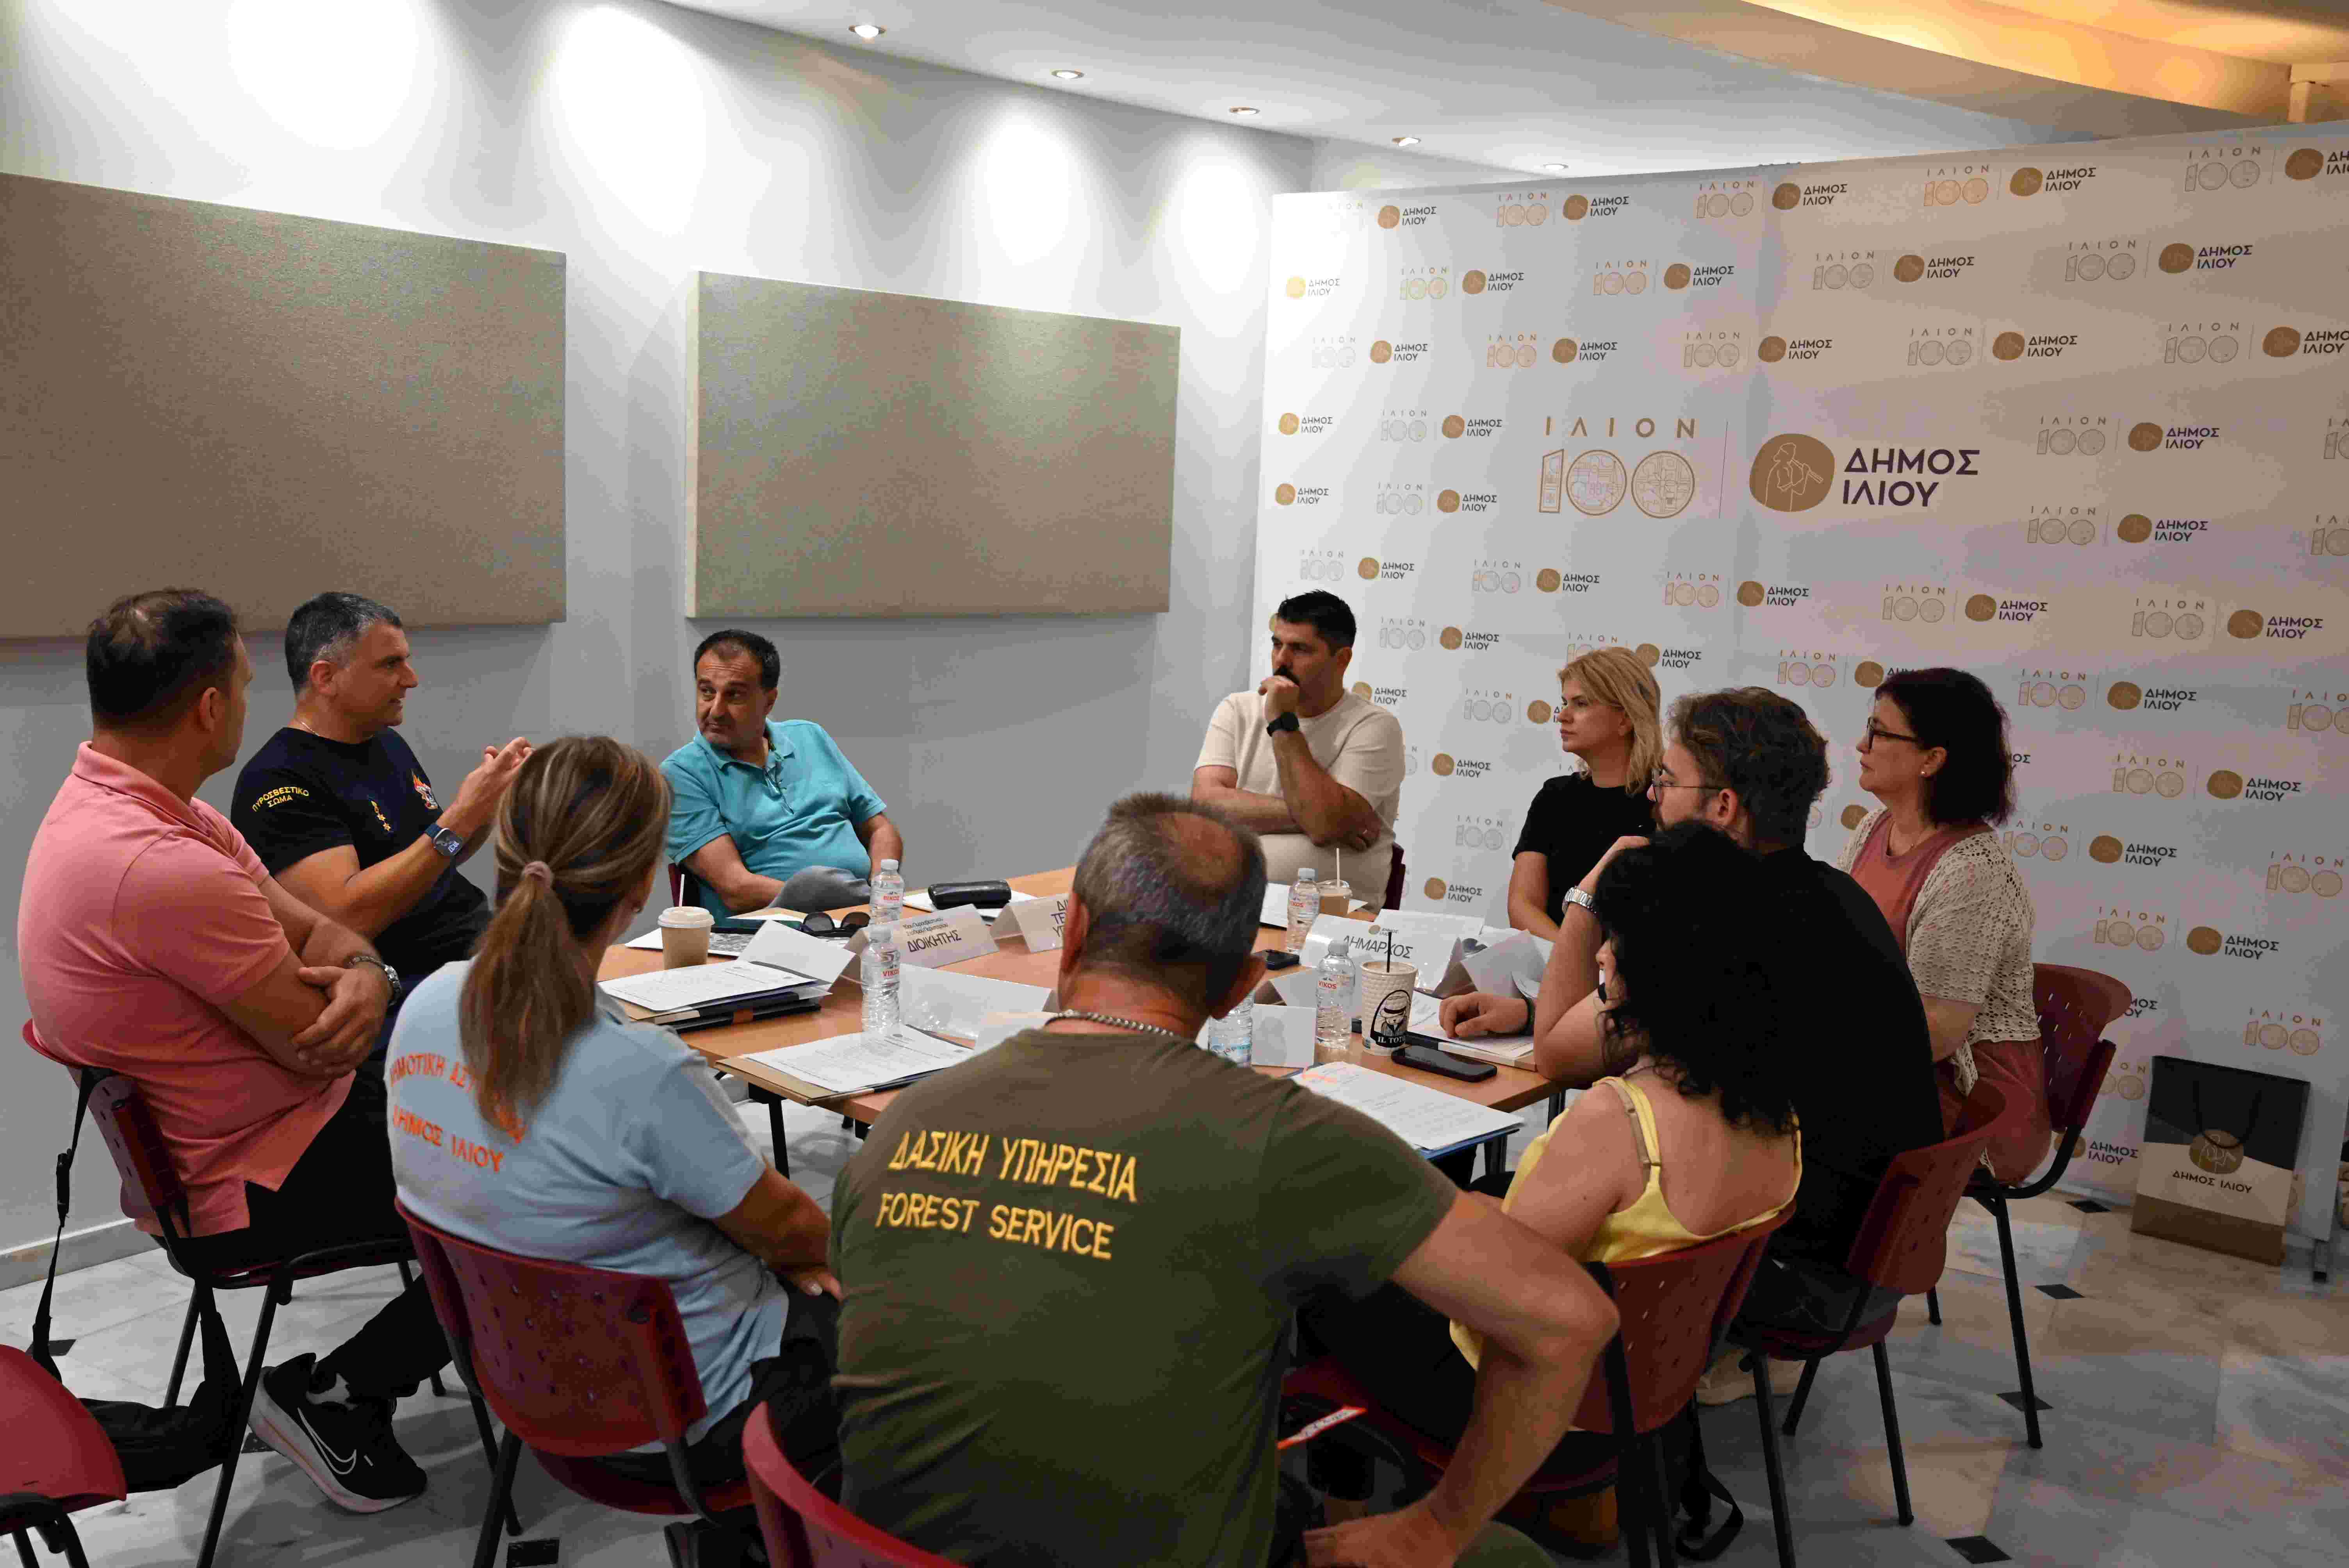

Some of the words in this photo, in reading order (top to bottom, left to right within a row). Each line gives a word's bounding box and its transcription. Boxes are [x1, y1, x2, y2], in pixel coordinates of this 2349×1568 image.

[2190, 147, 2260, 159] ΙΛΙΟΝ
[1927, 166, 1989, 176] ΙΛΙΟΝ
[2047, 168, 2096, 180] ΔΗΜΟΣ
[2327, 164, 2349, 175] ΙΛΙ
[1700, 181, 1754, 191] ΙΛΙΟΝ
[1804, 184, 1847, 194] ΔΗΜΟΣ
[2046, 180, 2081, 191] ΙΛΙΟΥ
[1499, 192, 1546, 201] ΙΛΙΟΝ
[1591, 196, 1629, 206] ΔΗΜΟΣ
[1804, 196, 1834, 205] ΙΛΙΟΥ
[1403, 207, 1436, 216] ΔΗΜΟΣ
[1591, 207, 1617, 216] ΙΛΙΟΥ
[1403, 217, 1426, 225] ΙΛΙΟΥ
[2069, 241, 2135, 250] ΙΛΙΟΝ
[1817, 251, 1874, 261] ΙΛΙΟΝ
[2199, 245, 2252, 257] ΔΗΜΟΣ
[1596, 260, 1646, 269] ΙΛΙΟΝ
[1928, 257, 1974, 267] ΔΗΜΟΣ
[2198, 258, 2236, 269] ΙΛΙΟΥ
[1694, 266, 1734, 275] ΔΗΜΟΣ
[1927, 269, 1960, 278] ΙΛΙΟΥ
[1489, 273, 1524, 281] ΔΗΜΟΣ
[1693, 277, 1722, 285] ΙΛΙΟΥ
[1912, 328, 1971, 336] ΙΛΙΟΝ
[2169, 323, 2239, 331] ΙΛΙΟΝ
[2029, 336, 2077, 345] ΔΗΜΟΣ
[2304, 331, 2349, 341] ΔΗΜΟ
[1790, 340, 1832, 349] ΔΗΜΟΣ
[2304, 344, 2345, 353] ΙΛΙΟΥ
[1580, 352, 1606, 360] ΙΛΙΟΥ
[1789, 351, 1819, 359] ΙΛΙΟΥ
[2028, 347, 2062, 356] ΙΛΙΟΥ
[2041, 417, 2105, 425] ΙΛΙΟΝ
[1546, 417, 1695, 438] ΙΛΙΟΝ
[2167, 428, 2219, 437] ΔΗΜΟΣ
[2166, 439, 2204, 449] ΙΛΙΟΥ
[1844, 448, 1980, 475] ΔΗΜΟΣ
[1463, 494, 1497, 502] ΔΗΜΟΣ
[1843, 480, 1939, 506] ΙΛΙΟΥ
[2031, 506, 2095, 515] ΙΛΙΟΝ
[2156, 520, 2208, 530] ΔΗΜΟΣ
[2155, 531, 2192, 541] ΙΛΙΟΥ
[1382, 562, 1414, 571] ΔΗΜΟΣ
[1475, 559, 1520, 568] ΙΛΙΟΝ
[1564, 574, 1599, 583] ΔΗΜΟΣ
[1668, 572, 1719, 581] ΙΛΙΟΝ
[1563, 583, 1588, 592] ΙΛΙΟΥ
[1768, 587, 1809, 597] ΔΗΜΟΣ
[1886, 584, 1945, 595] ΙΛΙΟΝ
[1767, 597, 1796, 606] ΙΛΙΟΥ
[2000, 600, 2048, 611] ΔΗΜΟΣ
[2137, 598, 2204, 609] ΙΛΙΟΝ
[1999, 611, 2033, 621] ΙΛΙΟΥ
[1381, 618, 1424, 626] ΙΛΙΟΝ
[2268, 617, 2323, 628] ΔΗΜΟΣ
[1465, 633, 1499, 642] ΔΗΜΟΣ
[1569, 633, 1617, 643] ΙΛΙΟΝ
[2267, 628, 2306, 639] ΙΛΙΟΥ
[1465, 641, 1488, 650] ΙΛΙΟΥ
[1663, 650, 1701, 659] ΔΗΜΟΣ
[1780, 650, 1835, 661] ΙΛΙΟΝ
[1662, 659, 1690, 668] ΙΛΙΟΥ
[2022, 669, 2085, 680] ΙΛΙΟΝ
[1375, 688, 1406, 697] ΔΗΜΟΣ
[1466, 688, 1511, 700] ΙΛΙΟΝ
[2145, 689, 2197, 701] ΔΗΜΟΣ
[2293, 690, 2349, 702] ΙΛΙΟ
[2144, 700, 2181, 711] ΙΛΙΟΥ
[1457, 760, 1490, 770] ΔΗΜΟΣ
[2118, 754, 2184, 768] ΙΛΙΟΝ
[1457, 768, 1481, 778] ΙΛΙΟΥ
[2246, 778, 2301, 791] ΔΗΜΟΣ
[252, 787, 309, 812] ΠΥΡΟΣΒΕΣΤΙΚΟ
[2246, 789, 2284, 801] ΙΛΙΟΥ
[267, 795, 294, 807] ΣΩΜΑ
[2016, 821, 2068, 833] ΛΙΟΝ
[2126, 843, 2177, 857] ΔΗΜΟΣ
[2126, 854, 2161, 866] ΙΛΙΟΥ
[2271, 851, 2343, 868] ΙΛΙΟΝ
[1449, 884, 1482, 896] ΔΗΜΟΣ
[1448, 893, 1472, 902] ΙΛΙΟΥ
[2099, 907, 2165, 923] ΙΛΙΟΝ
[907, 930, 962, 952] ΔΙΟΙΚΗΤΗΣ
[2225, 936, 2279, 950] ΔΗΜΟΣ
[2225, 946, 2263, 959] ΙΛΙΟΥ
[1318, 980, 1337, 989] VIKOS
[2131, 998, 2158, 1010] ΜΟΣ
[2249, 1008, 2320, 1026] ΙΛΙΟΝ
[393, 1105, 443, 1146] ΗΜΟΣ
[451, 1133, 504, 1173] ΙΛΙΟΥ
[2090, 1141, 2138, 1158] ΔΗΜΟΣ
[2089, 1151, 2123, 1165] ΙΛΙΟΥ
[888, 1129, 989, 1177] ΔΑΣΙΚΗ
[999, 1137, 1137, 1203] ΥΠΗΡΕΣΙΑ
[2173, 1171, 2215, 1186] ΔΗΜΟΣ
[2221, 1181, 2252, 1193] ΙΛΙΟΥ
[875, 1192, 980, 1233] FOREST
[989, 1205, 1115, 1260] SERVICE
